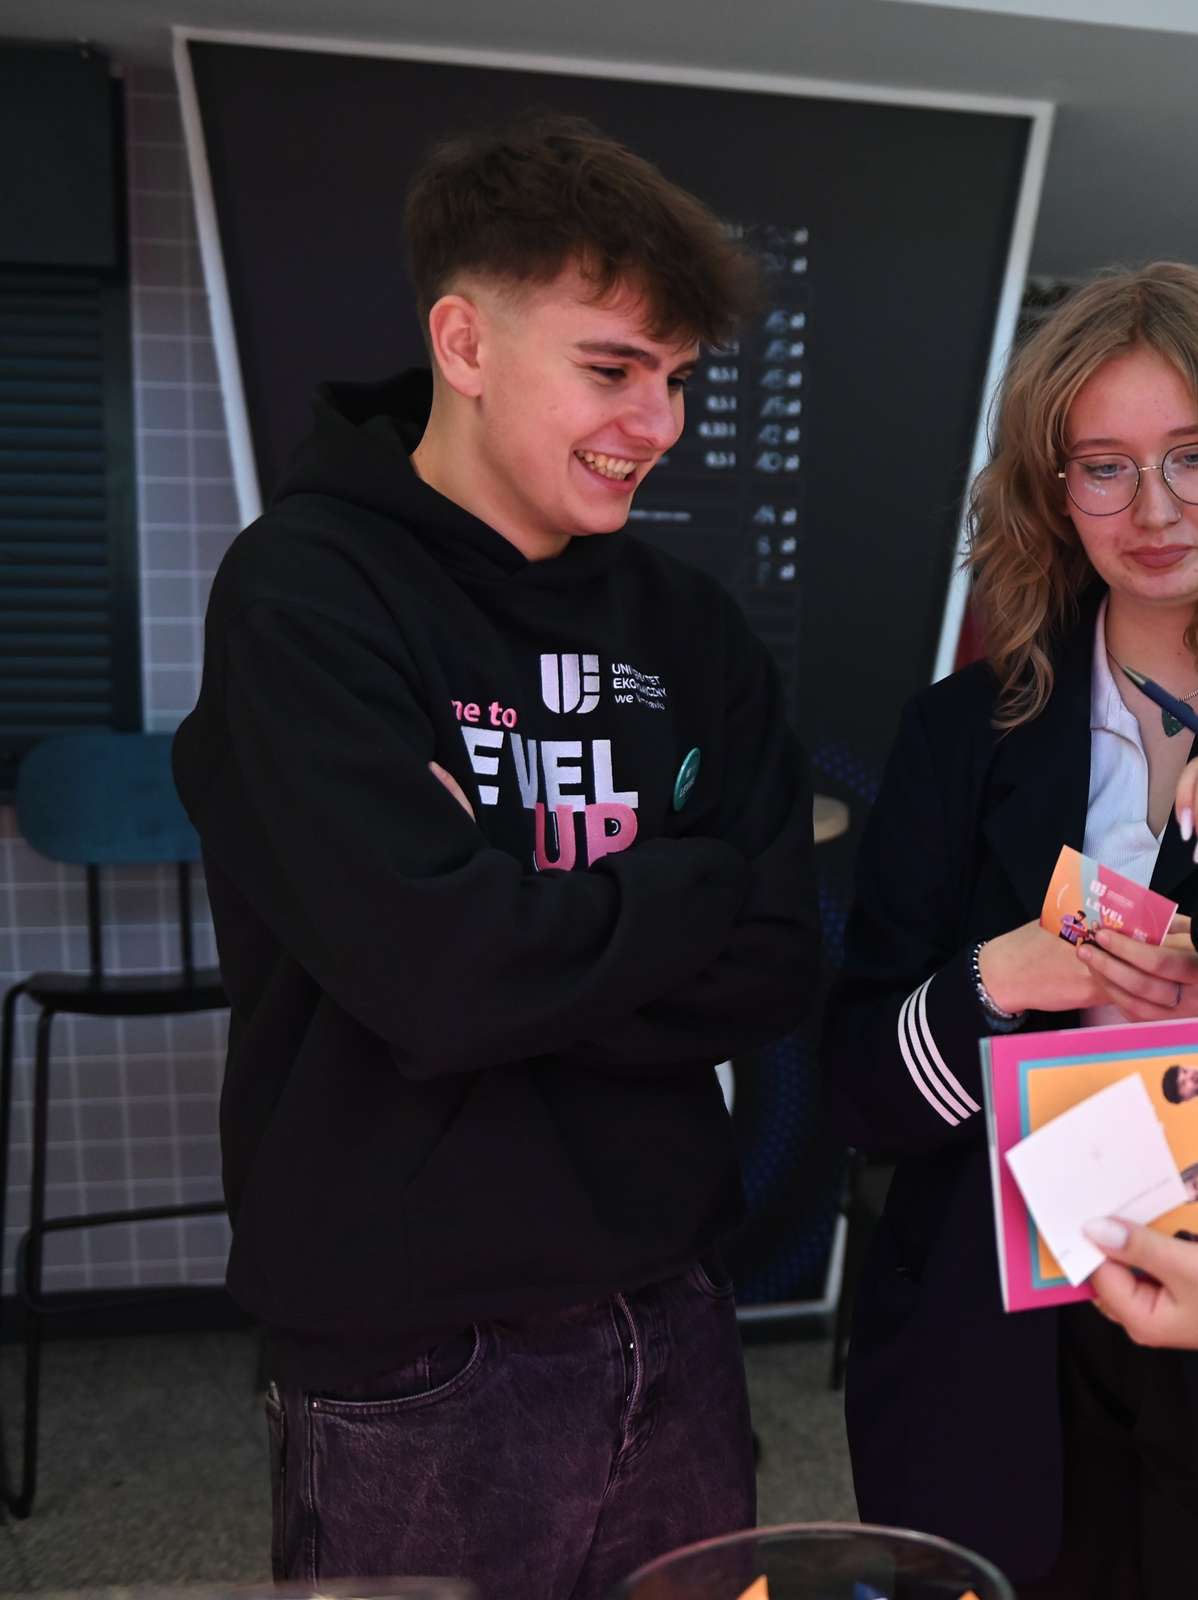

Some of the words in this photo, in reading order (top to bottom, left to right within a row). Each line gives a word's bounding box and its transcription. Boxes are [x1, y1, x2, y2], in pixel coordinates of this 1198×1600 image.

[612, 663, 660, 685] UNIYTET
[613, 677, 667, 698] EKOCZNY
[614, 694, 634, 704] we
[488, 701, 519, 729] to
[460, 723, 639, 813] EVEL
[533, 801, 639, 873] UP
